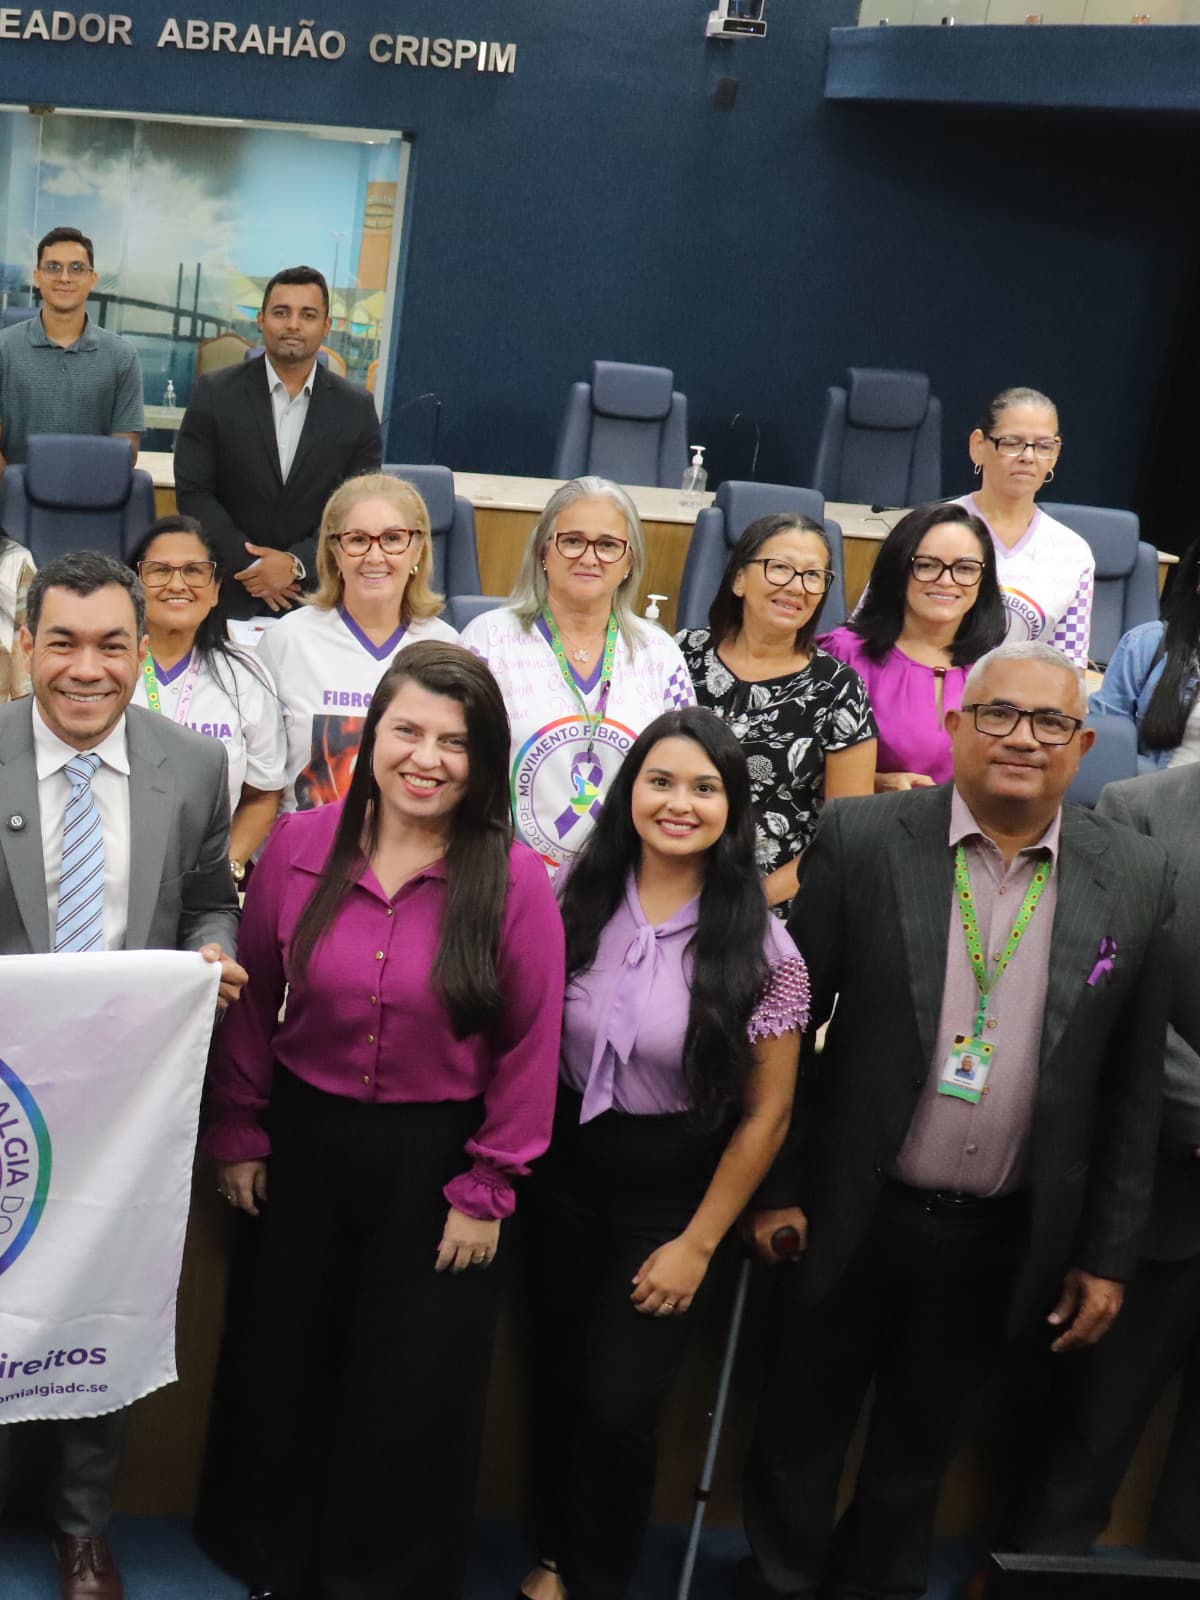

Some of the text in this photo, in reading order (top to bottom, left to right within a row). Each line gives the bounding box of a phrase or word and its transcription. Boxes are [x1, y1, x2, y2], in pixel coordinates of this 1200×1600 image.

[157, 19, 346, 60] ABRAHÃO
[369, 34, 517, 74] CRISPIM
[520, 726, 579, 796] MOVIMENTO
[520, 801, 560, 859] SERGIPE
